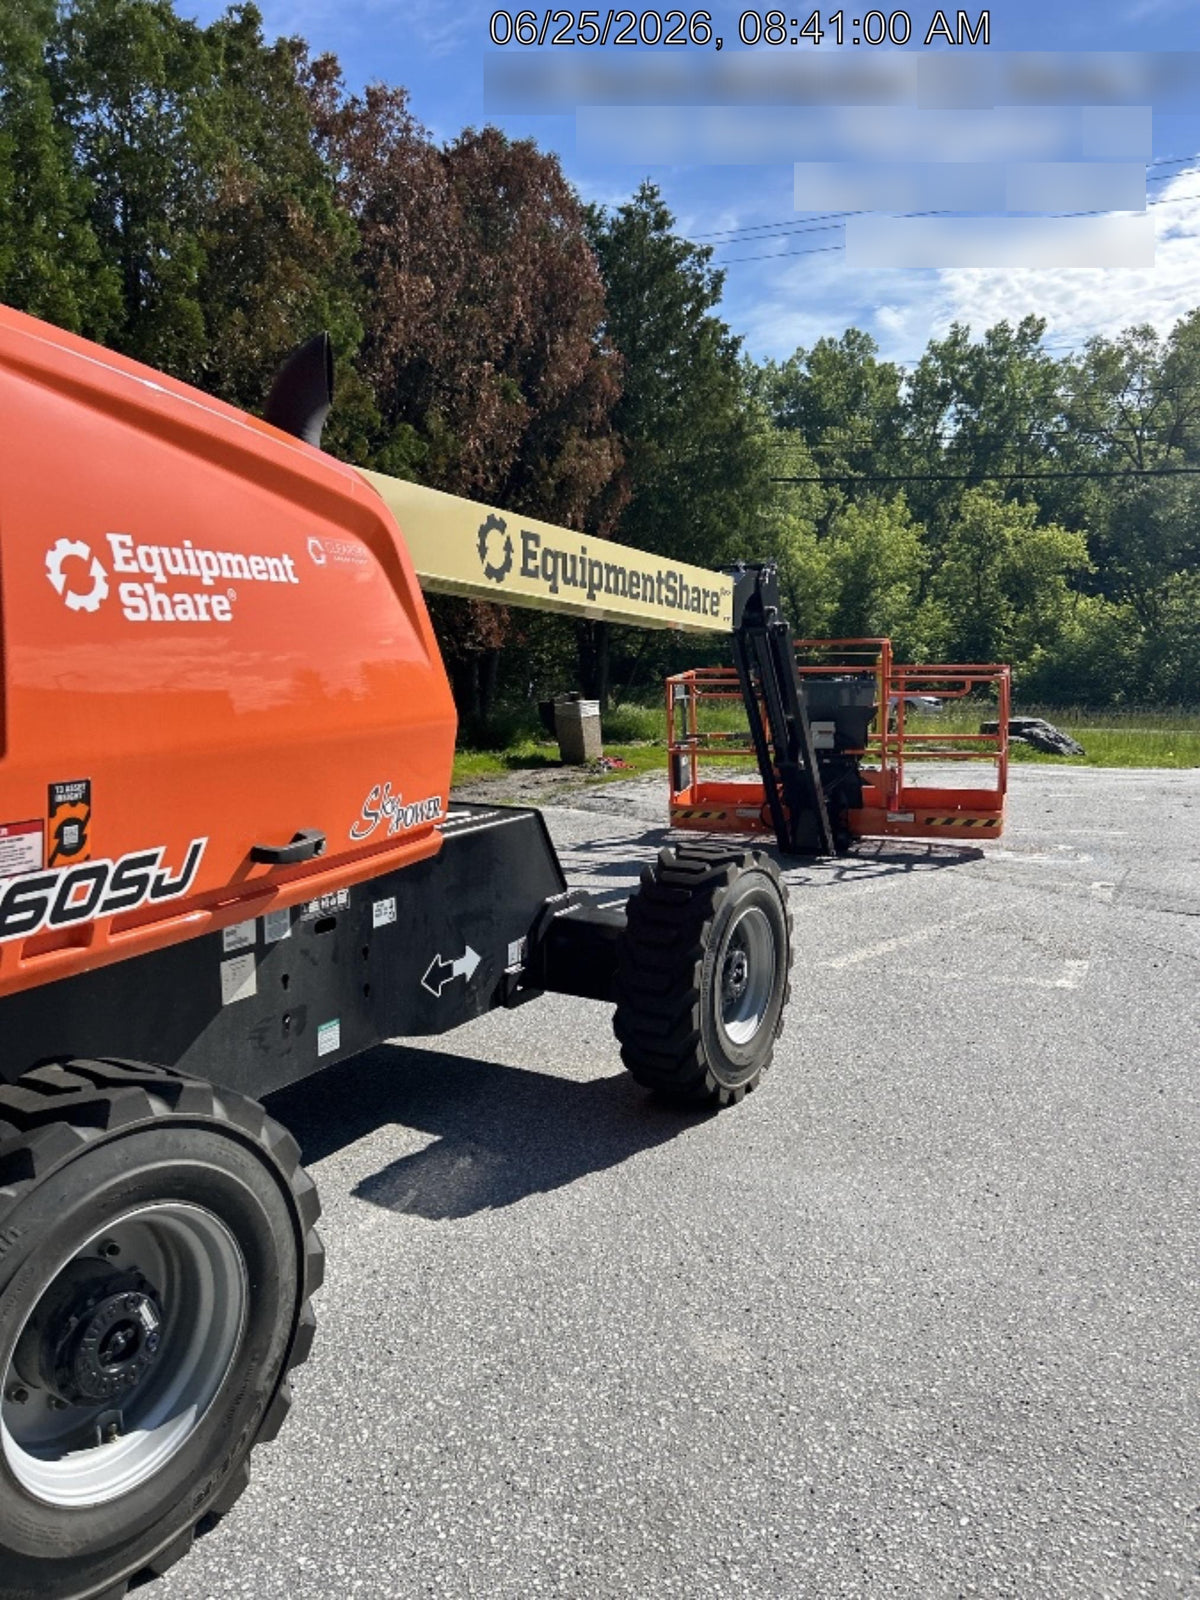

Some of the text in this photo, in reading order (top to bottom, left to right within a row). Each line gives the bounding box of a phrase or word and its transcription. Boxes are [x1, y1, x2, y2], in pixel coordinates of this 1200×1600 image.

[106, 532, 300, 586] Equipment
[520, 529, 721, 618] EquipmentShare
[395, 796, 442, 832] POWER
[0, 837, 208, 942] 60SJ
